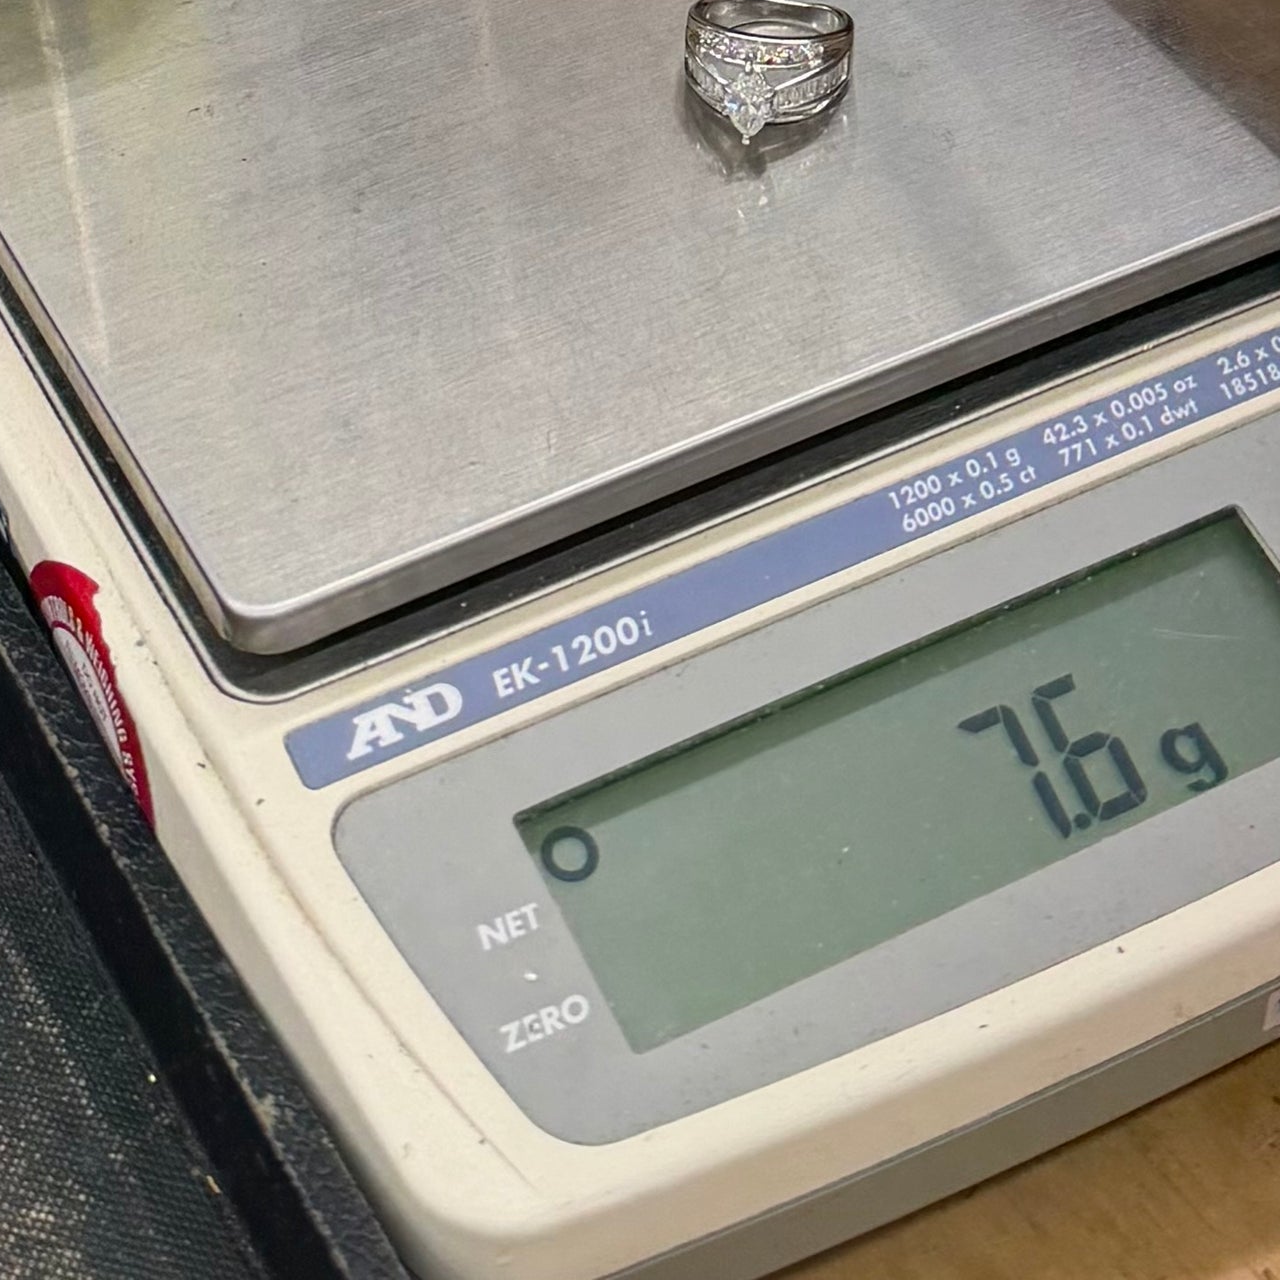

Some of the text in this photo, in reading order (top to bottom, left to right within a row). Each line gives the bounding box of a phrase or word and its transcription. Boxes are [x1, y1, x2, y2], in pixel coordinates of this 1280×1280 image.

[888, 474, 942, 510] 1200
[966, 451, 999, 479] 0.1
[1005, 448, 1021, 468] g
[1042, 414, 1088, 447] 42.3
[1111, 382, 1168, 419] 0.005
[1174, 375, 1198, 392] oz
[1216, 349, 1251, 375] 2.6
[902, 497, 955, 532] 6000
[980, 472, 1014, 500] 0.5
[1020, 465, 1037, 484] ct
[1058, 438, 1097, 467] 771
[1121, 415, 1154, 441] 0.1
[1160, 399, 1199, 427] dwt
[491, 610, 653, 698] EK-1200i
[957, 672, 1229, 840] 7.6 g
[477, 902, 539, 951] NET
[499, 994, 590, 1054] ZERO
